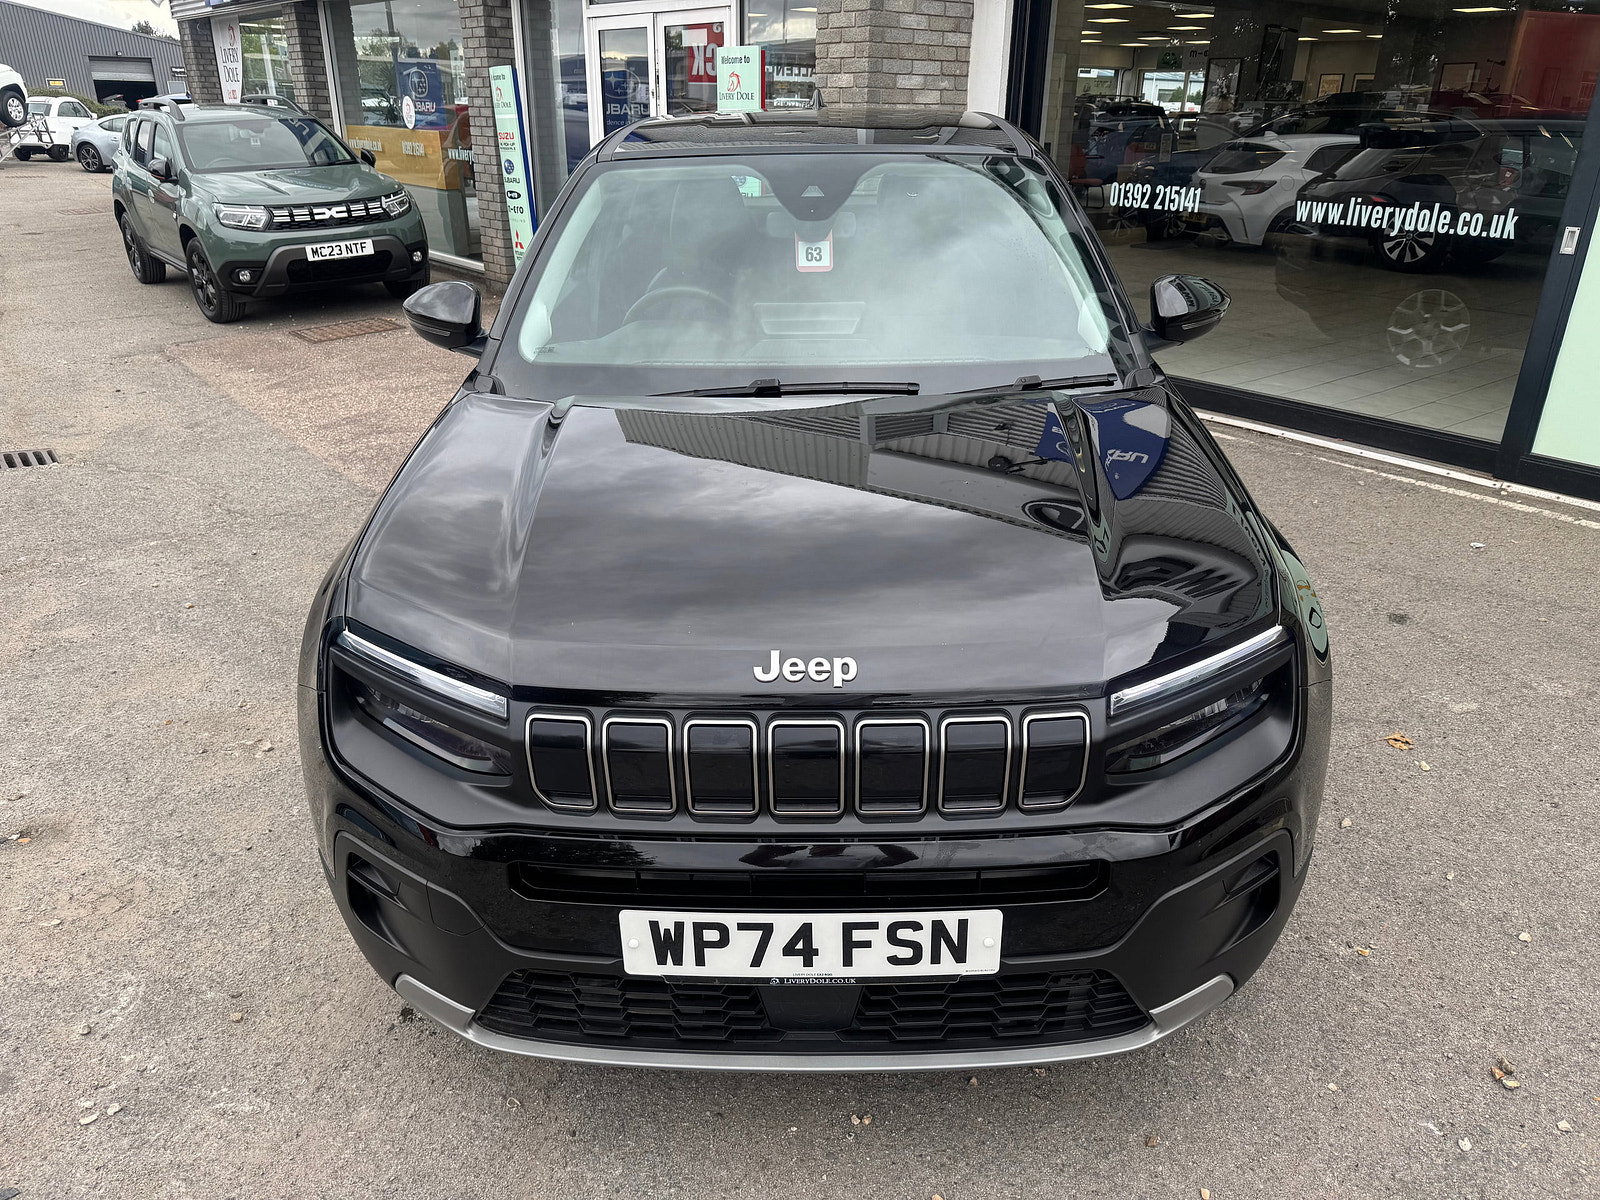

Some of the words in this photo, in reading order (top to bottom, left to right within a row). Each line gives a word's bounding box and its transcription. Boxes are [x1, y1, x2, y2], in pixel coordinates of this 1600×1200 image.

[220, 46, 239, 63] LIVERY
[721, 55, 742, 65] Welcome
[743, 55, 751, 64] to
[223, 65, 240, 82] DOLE
[719, 92, 736, 101] LIVERY
[736, 92, 755, 101] DOLE
[414, 101, 436, 112] UBARU
[1109, 181, 1152, 209] 01392
[1153, 184, 1202, 213] 215141
[1295, 197, 1519, 240] www.liverydole.co.uk
[311, 244, 343, 259] MC23
[344, 242, 367, 256] NTF
[805, 246, 823, 262] 63
[753, 649, 858, 689] Jeep
[648, 919, 820, 968] WP74
[841, 918, 970, 968] FSN
